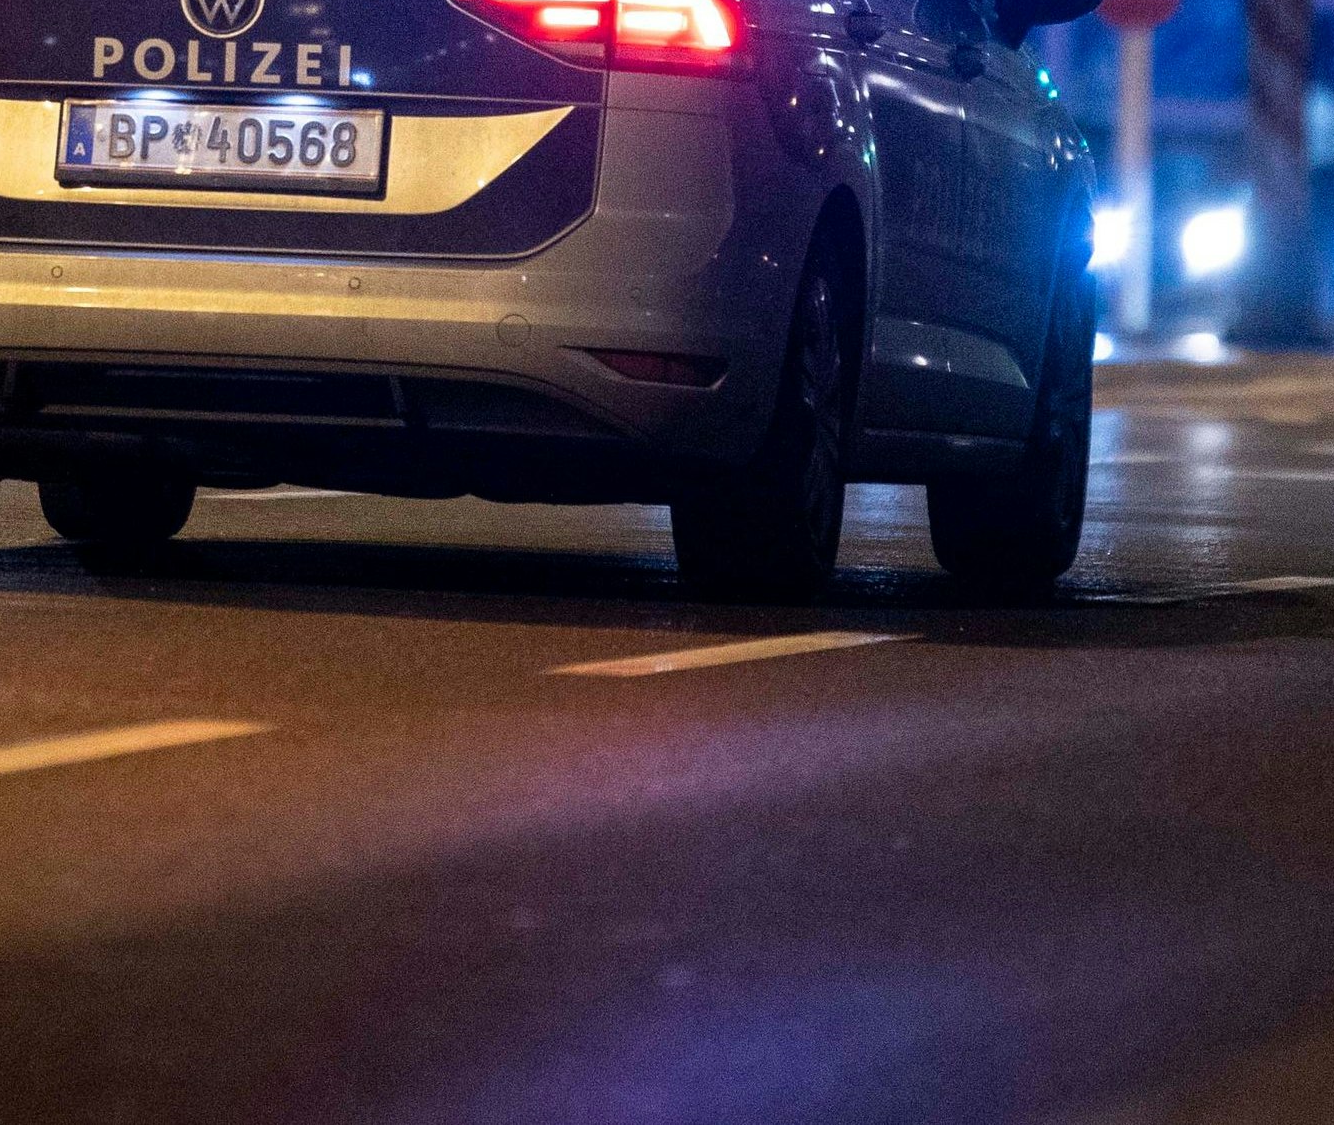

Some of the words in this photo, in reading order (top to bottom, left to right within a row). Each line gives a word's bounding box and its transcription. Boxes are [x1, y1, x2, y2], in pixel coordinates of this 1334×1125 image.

[93, 36, 352, 87] POLIZEI
[72, 141, 86, 157] A
[108, 112, 168, 161] BP
[206, 115, 359, 169] 40568
